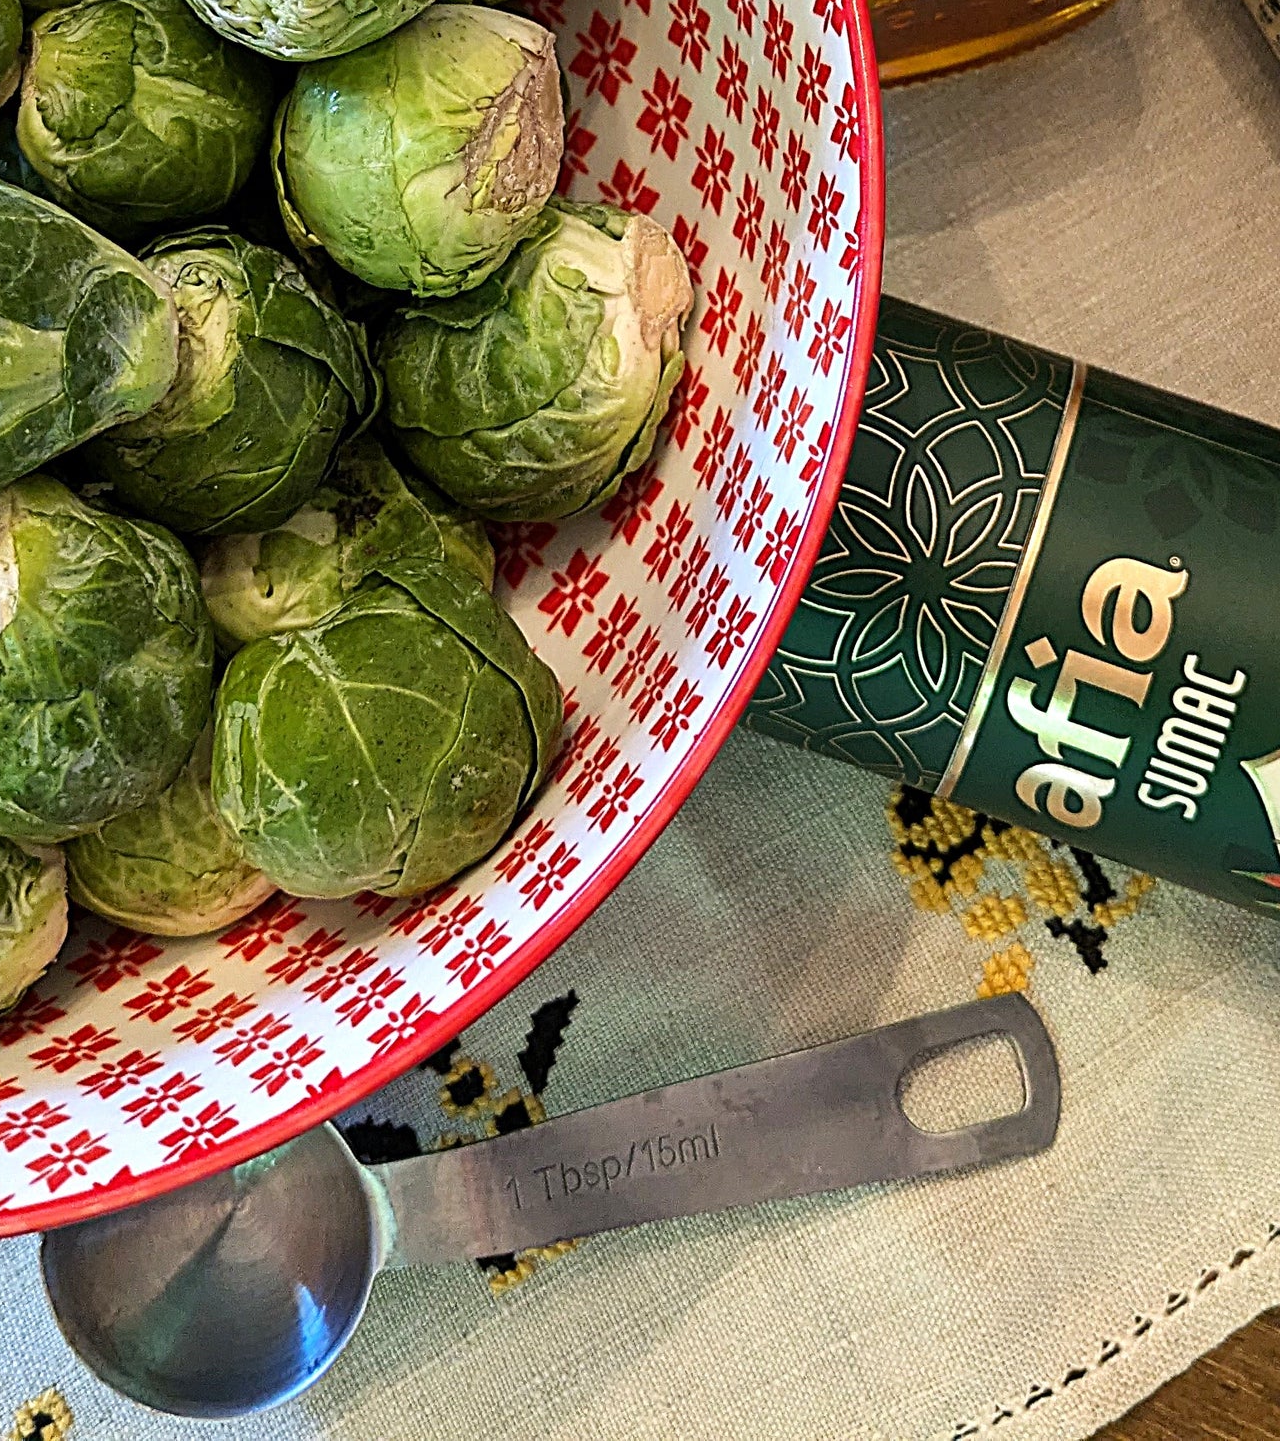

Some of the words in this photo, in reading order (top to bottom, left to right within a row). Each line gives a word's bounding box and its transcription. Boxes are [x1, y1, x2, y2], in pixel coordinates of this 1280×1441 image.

[1007, 557, 1189, 828] afia
[1137, 654, 1247, 820] SUMAC
[506, 1175, 521, 1209] 1
[533, 1123, 720, 1201] Tbsp/15ml
